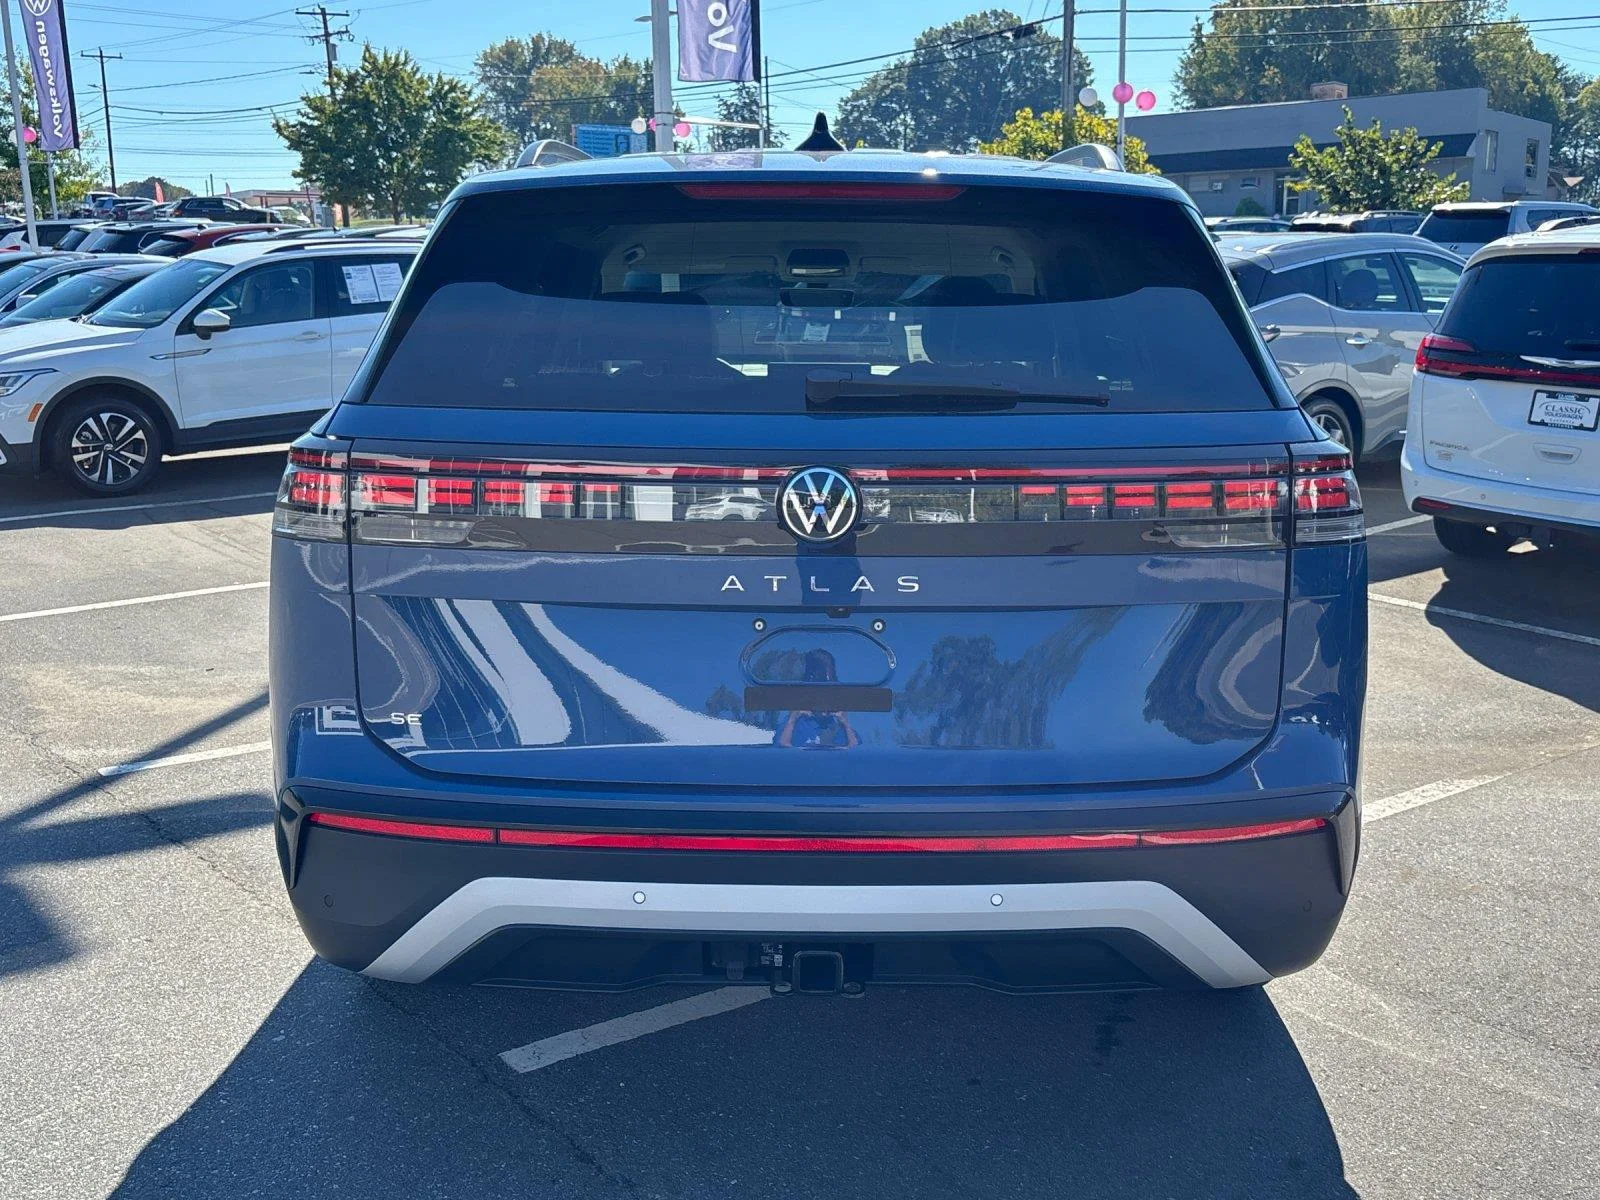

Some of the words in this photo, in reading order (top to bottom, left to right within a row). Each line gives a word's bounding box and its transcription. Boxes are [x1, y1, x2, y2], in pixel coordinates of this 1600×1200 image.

[1544, 411, 1584, 420] VOLKSWAGEN
[1545, 404, 1584, 415] CLASSIC
[720, 575, 920, 593] ATLAS
[390, 712, 423, 726] SE
